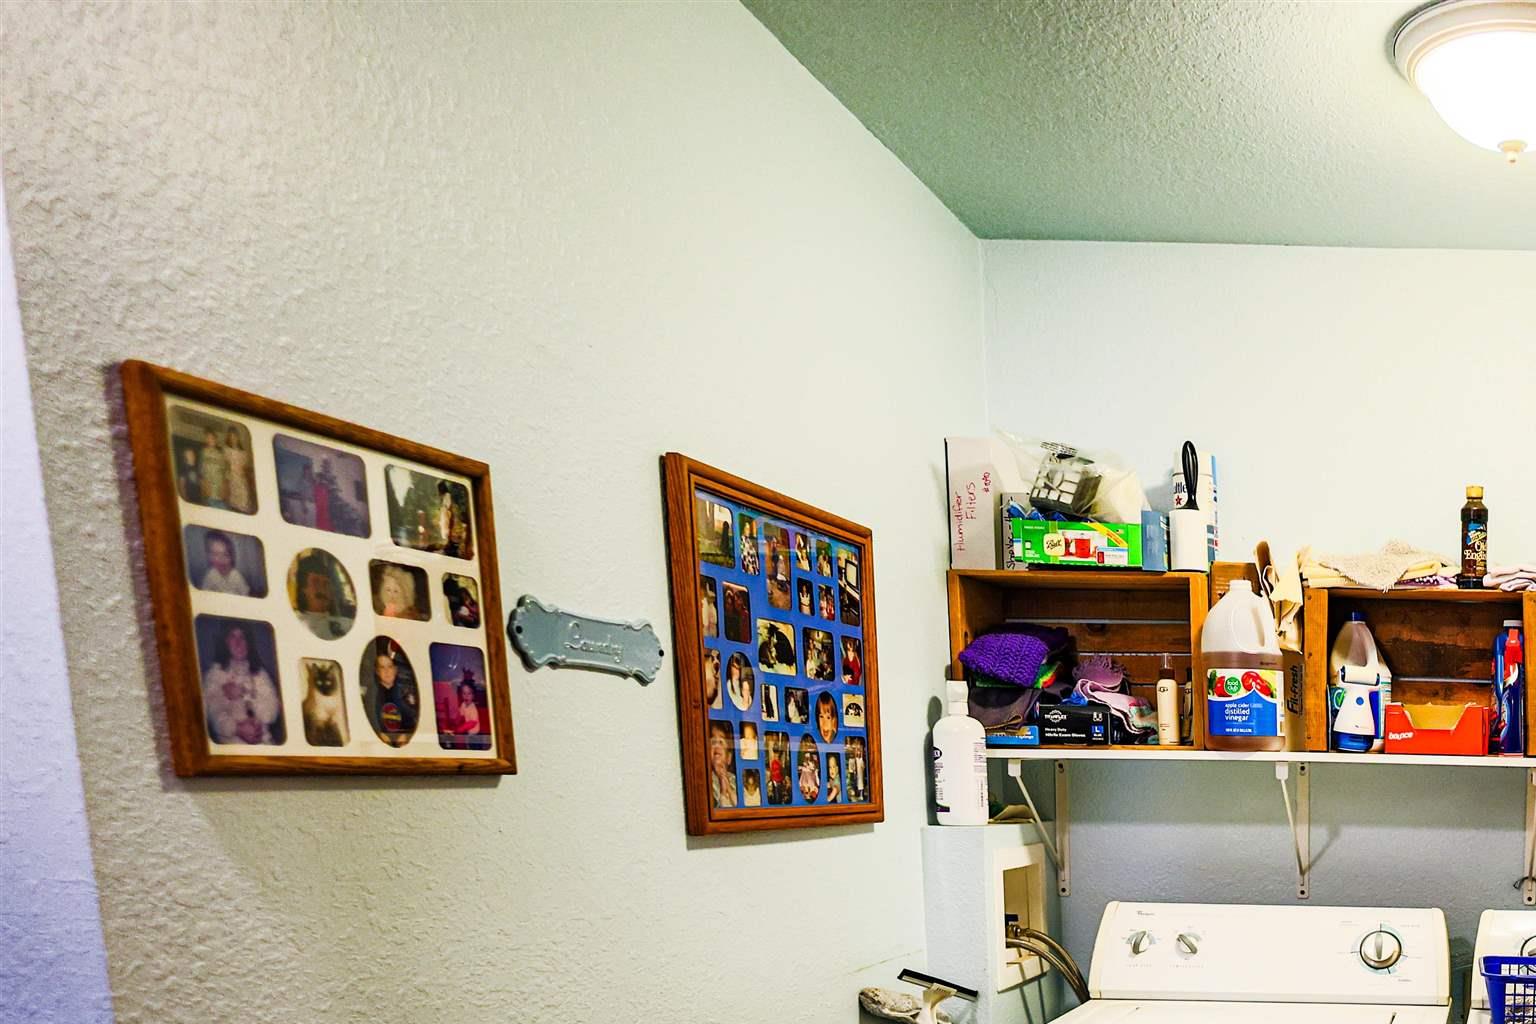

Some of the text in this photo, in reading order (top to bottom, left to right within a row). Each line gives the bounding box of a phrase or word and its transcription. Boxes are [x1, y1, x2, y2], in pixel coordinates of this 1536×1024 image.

[966, 481, 976, 520] Filters
[952, 492, 965, 551] Humidifier
[1224, 714, 1249, 722] vinegar
[1388, 731, 1414, 740] bounce
